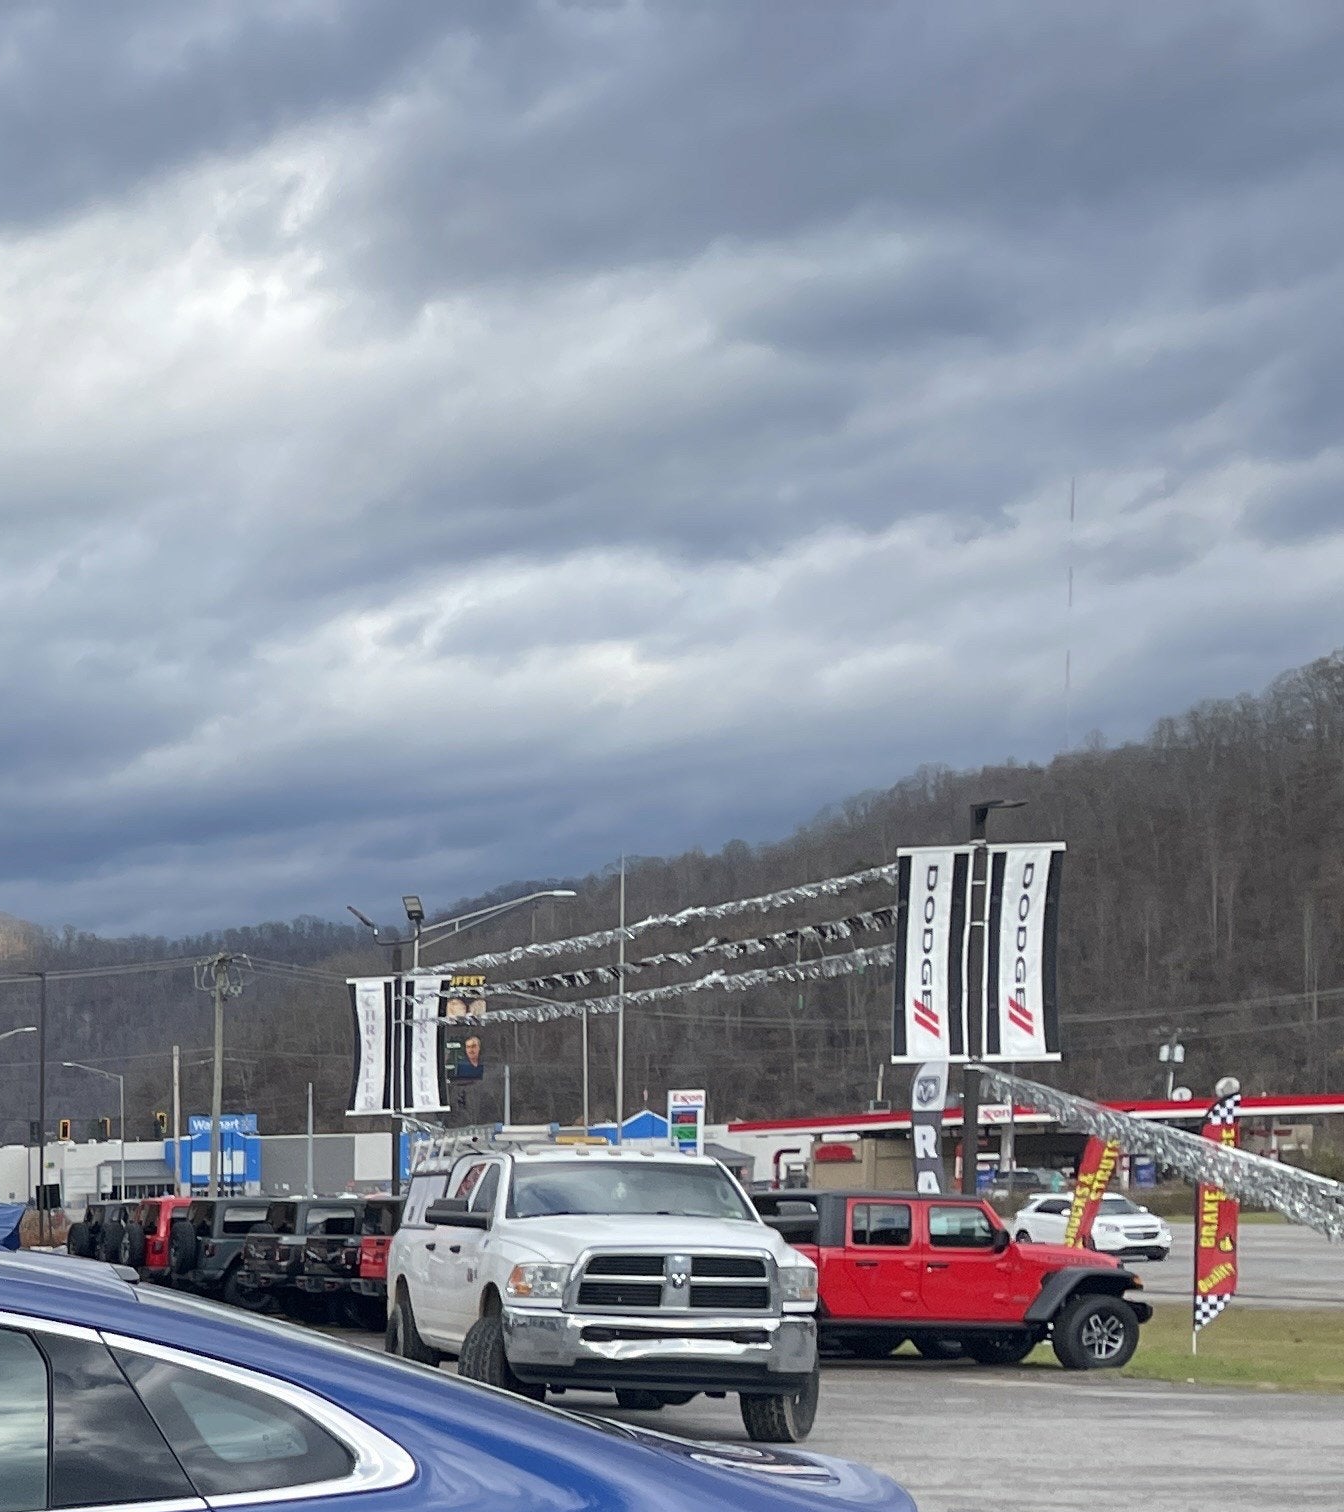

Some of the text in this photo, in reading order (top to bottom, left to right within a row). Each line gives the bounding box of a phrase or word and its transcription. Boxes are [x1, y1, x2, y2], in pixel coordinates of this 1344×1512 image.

[921, 865, 939, 1013] DODGE
[1015, 863, 1035, 1011] DODGE
[362, 995, 375, 1107] CHRYSLER
[417, 994, 432, 1106] HRYSLER
[914, 1125, 941, 1194] RA
[983, 1109, 1012, 1122] xxon
[1199, 1190, 1219, 1248] BRAKE
[1198, 1262, 1235, 1293] Quality
